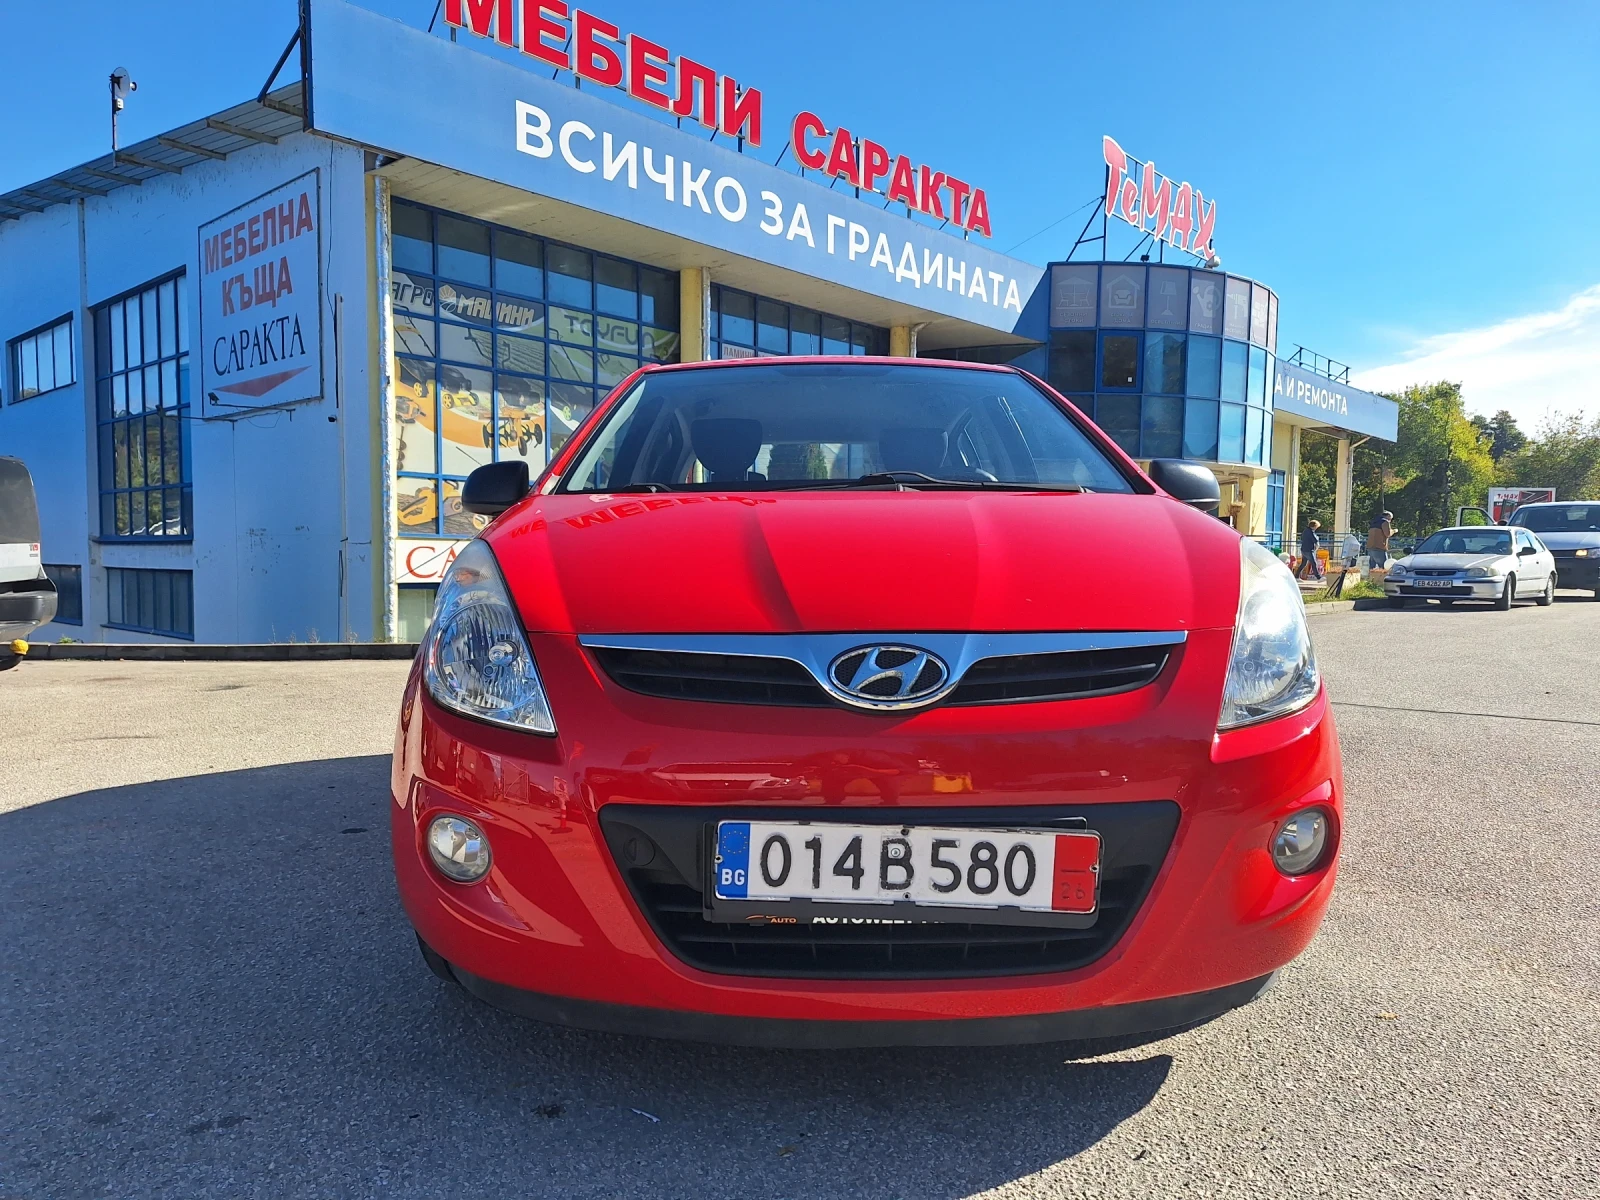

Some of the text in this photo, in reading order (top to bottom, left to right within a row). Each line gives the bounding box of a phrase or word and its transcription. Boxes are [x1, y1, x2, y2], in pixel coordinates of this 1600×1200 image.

[515, 99, 1022, 313] ВСИЧКО ЗА ГРАДИНАТА
[791, 111, 993, 238] САРАКТА
[204, 192, 313, 275] МЕБЕЛНА
[222, 256, 293, 316] КЪЩА
[213, 312, 306, 376] САРАКТА
[1286, 375, 1295, 399] И
[1297, 379, 1348, 416] РЕМОНТА
[721, 868, 746, 886] BG
